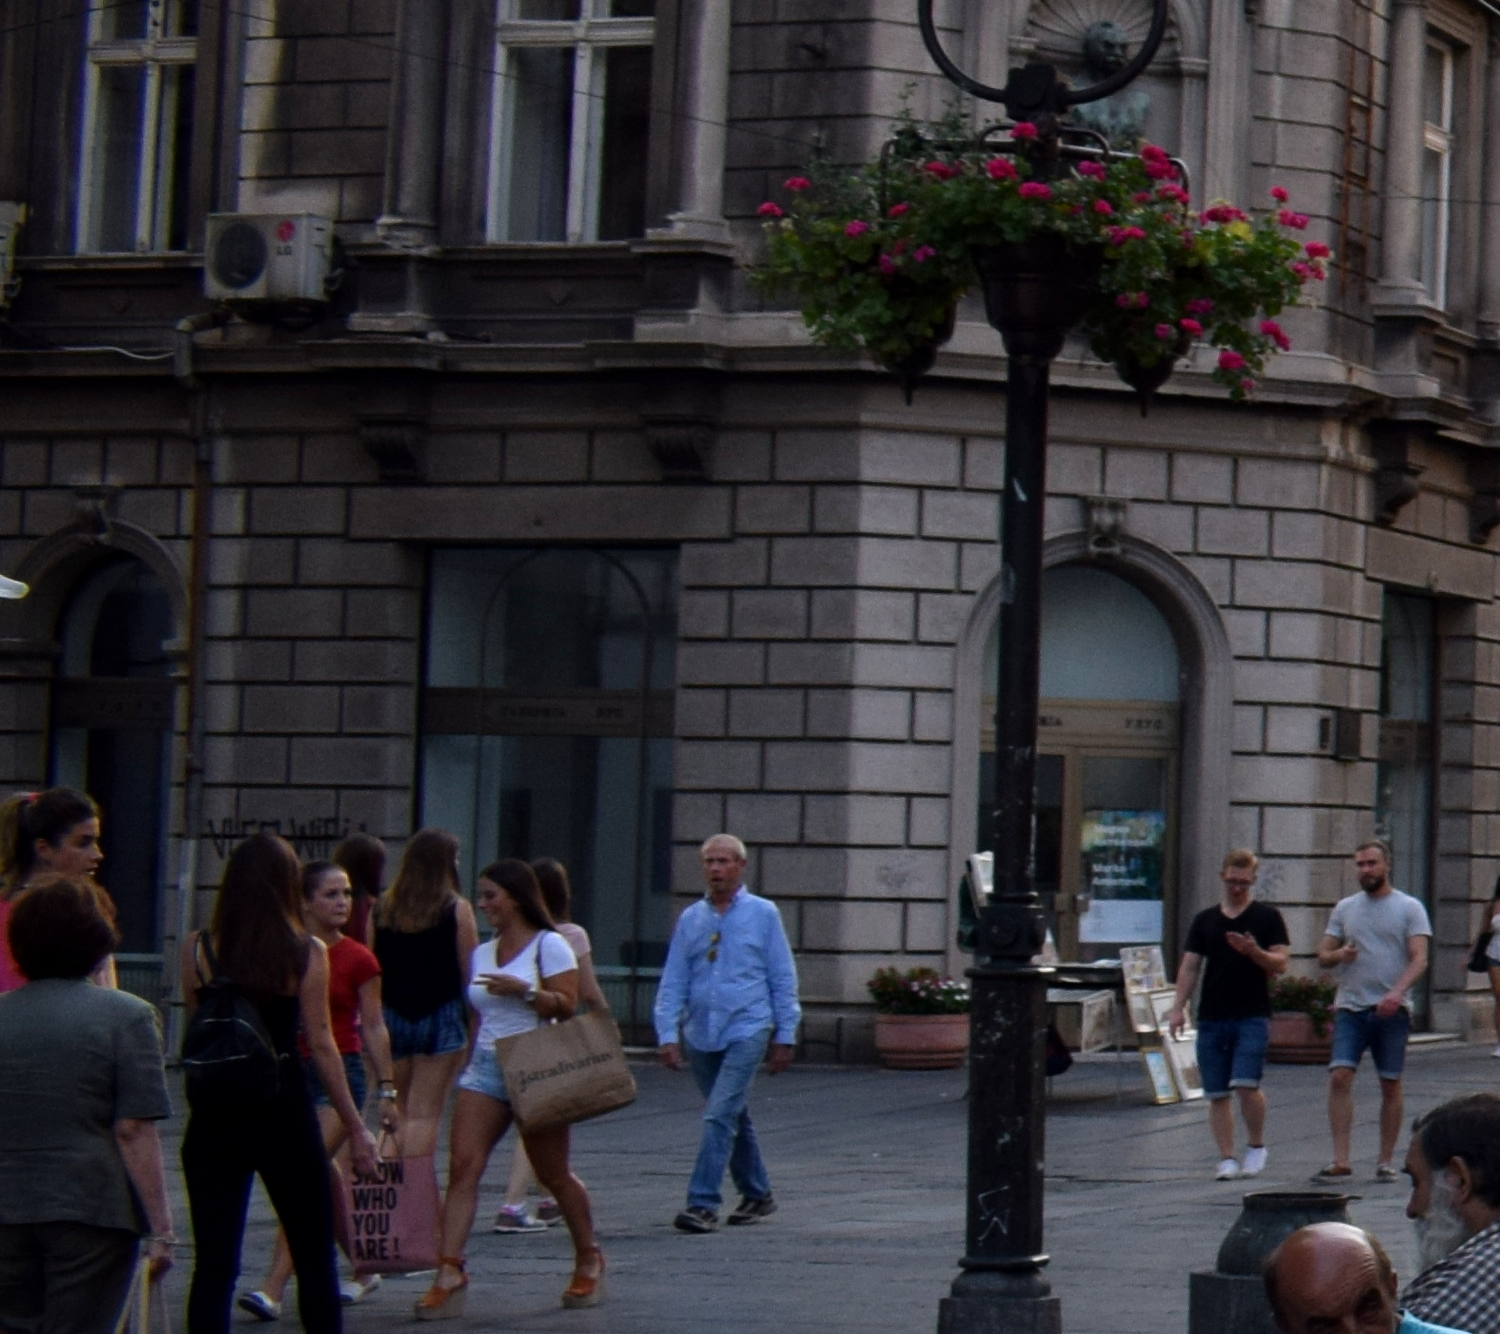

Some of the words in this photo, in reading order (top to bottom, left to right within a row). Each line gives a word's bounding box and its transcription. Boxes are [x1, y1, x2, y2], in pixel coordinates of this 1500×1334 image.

[352, 1187, 397, 1211] WHO
[352, 1212, 390, 1236] YOU
[354, 1238, 389, 1261] ARE
